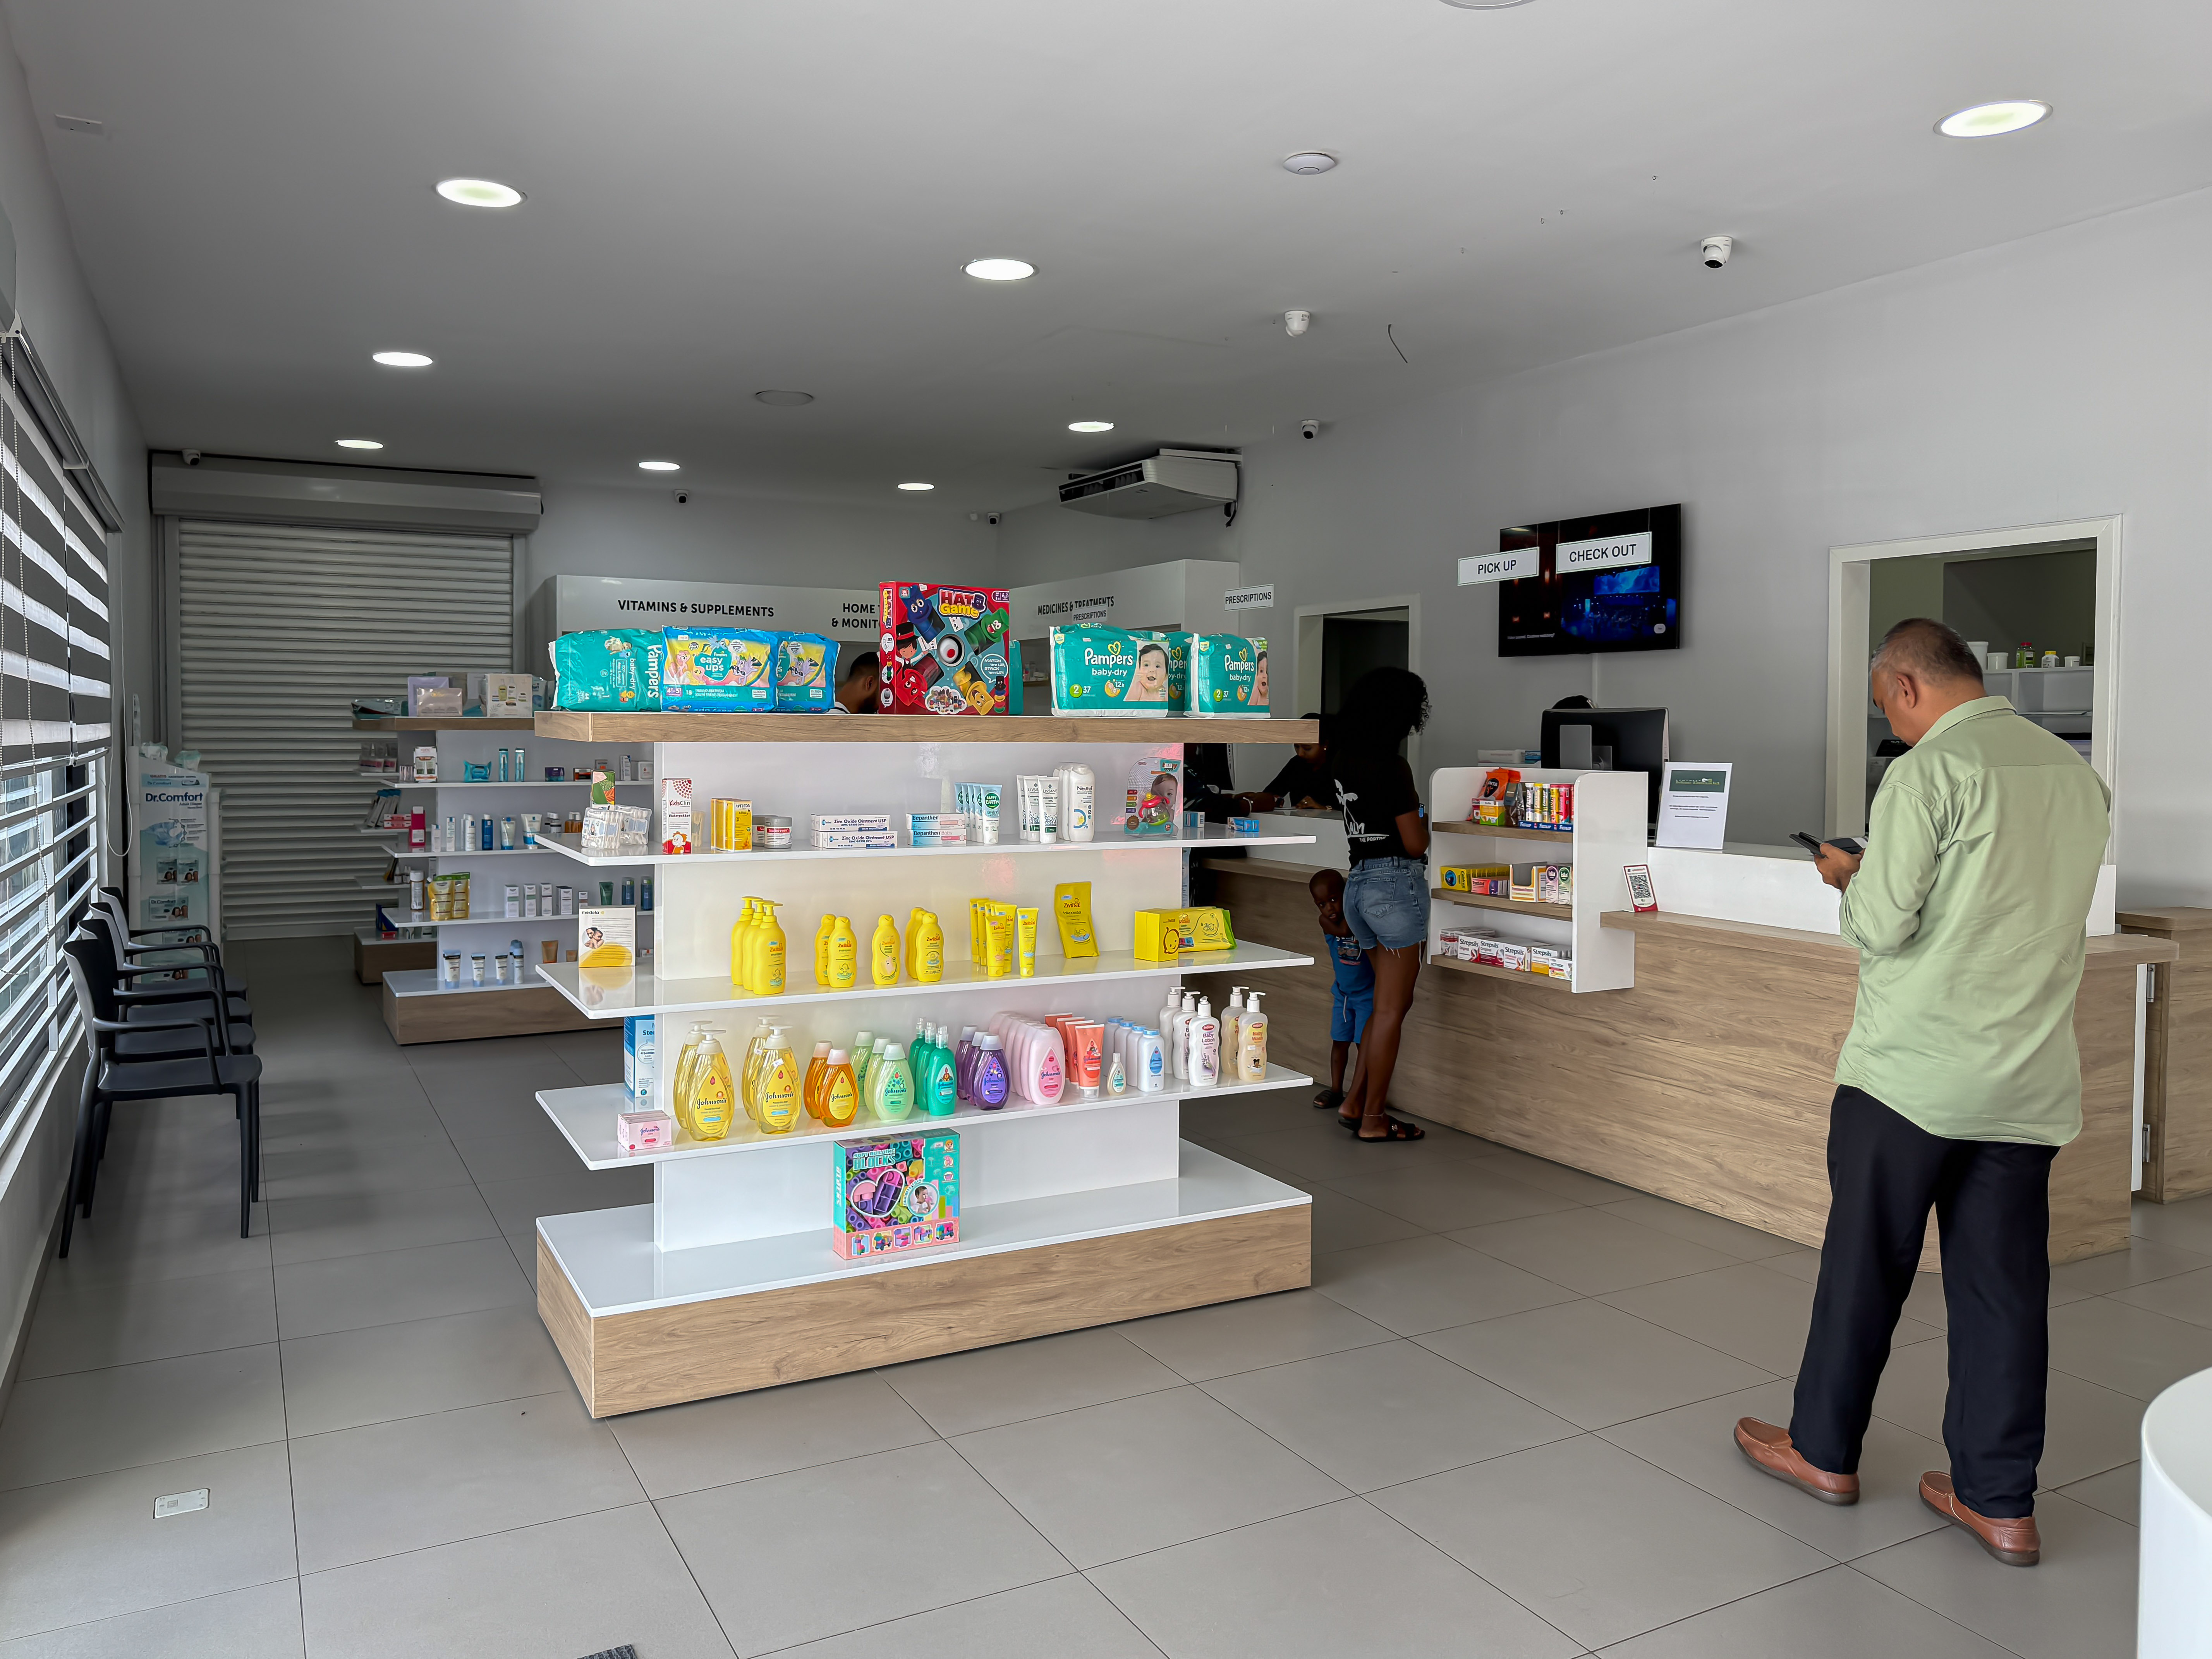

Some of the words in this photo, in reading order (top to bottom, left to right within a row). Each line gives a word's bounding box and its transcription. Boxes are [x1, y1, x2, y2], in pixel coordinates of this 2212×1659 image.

[1569, 547, 1608, 562] CHECK
[1612, 544, 1637, 557] OUT
[1478, 562, 1500, 575] PICK
[1503, 560, 1516, 571] UP
[940, 590, 974, 606] HAT
[1225, 592, 1271, 604] PRESCRIPTIONS
[618, 600, 677, 612] VITAMINS
[680, 603, 688, 613] &
[691, 603, 774, 617] SUPPLEMENTS
[843, 603, 875, 613] HOME
[940, 603, 979, 617] Game
[1038, 602, 1068, 615] MEDICINES
[1070, 601, 1073, 611] &
[1073, 610, 1106, 621] PRESCRIPTIONS
[832, 618, 838, 627] &
[842, 618, 879, 629] MONIT
[700, 656, 723, 665] easy
[1085, 648, 1133, 668] Pampers
[1224, 654, 1254, 673] Pampers
[1092, 668, 1127, 677] baby-dry
[1230, 674, 1251, 682] baby-dry
[146, 792, 203, 802] Dr.Comfort
[1460, 938, 1479, 947] Strepsils
[1505, 947, 1524, 955] Strepsils
[697, 1097, 727, 1109] Johnson's
[765, 1091, 794, 1103] Johnson's
[869, 1148, 896, 1156] BUILDING
[853, 1155, 896, 1170] BLOCKS
